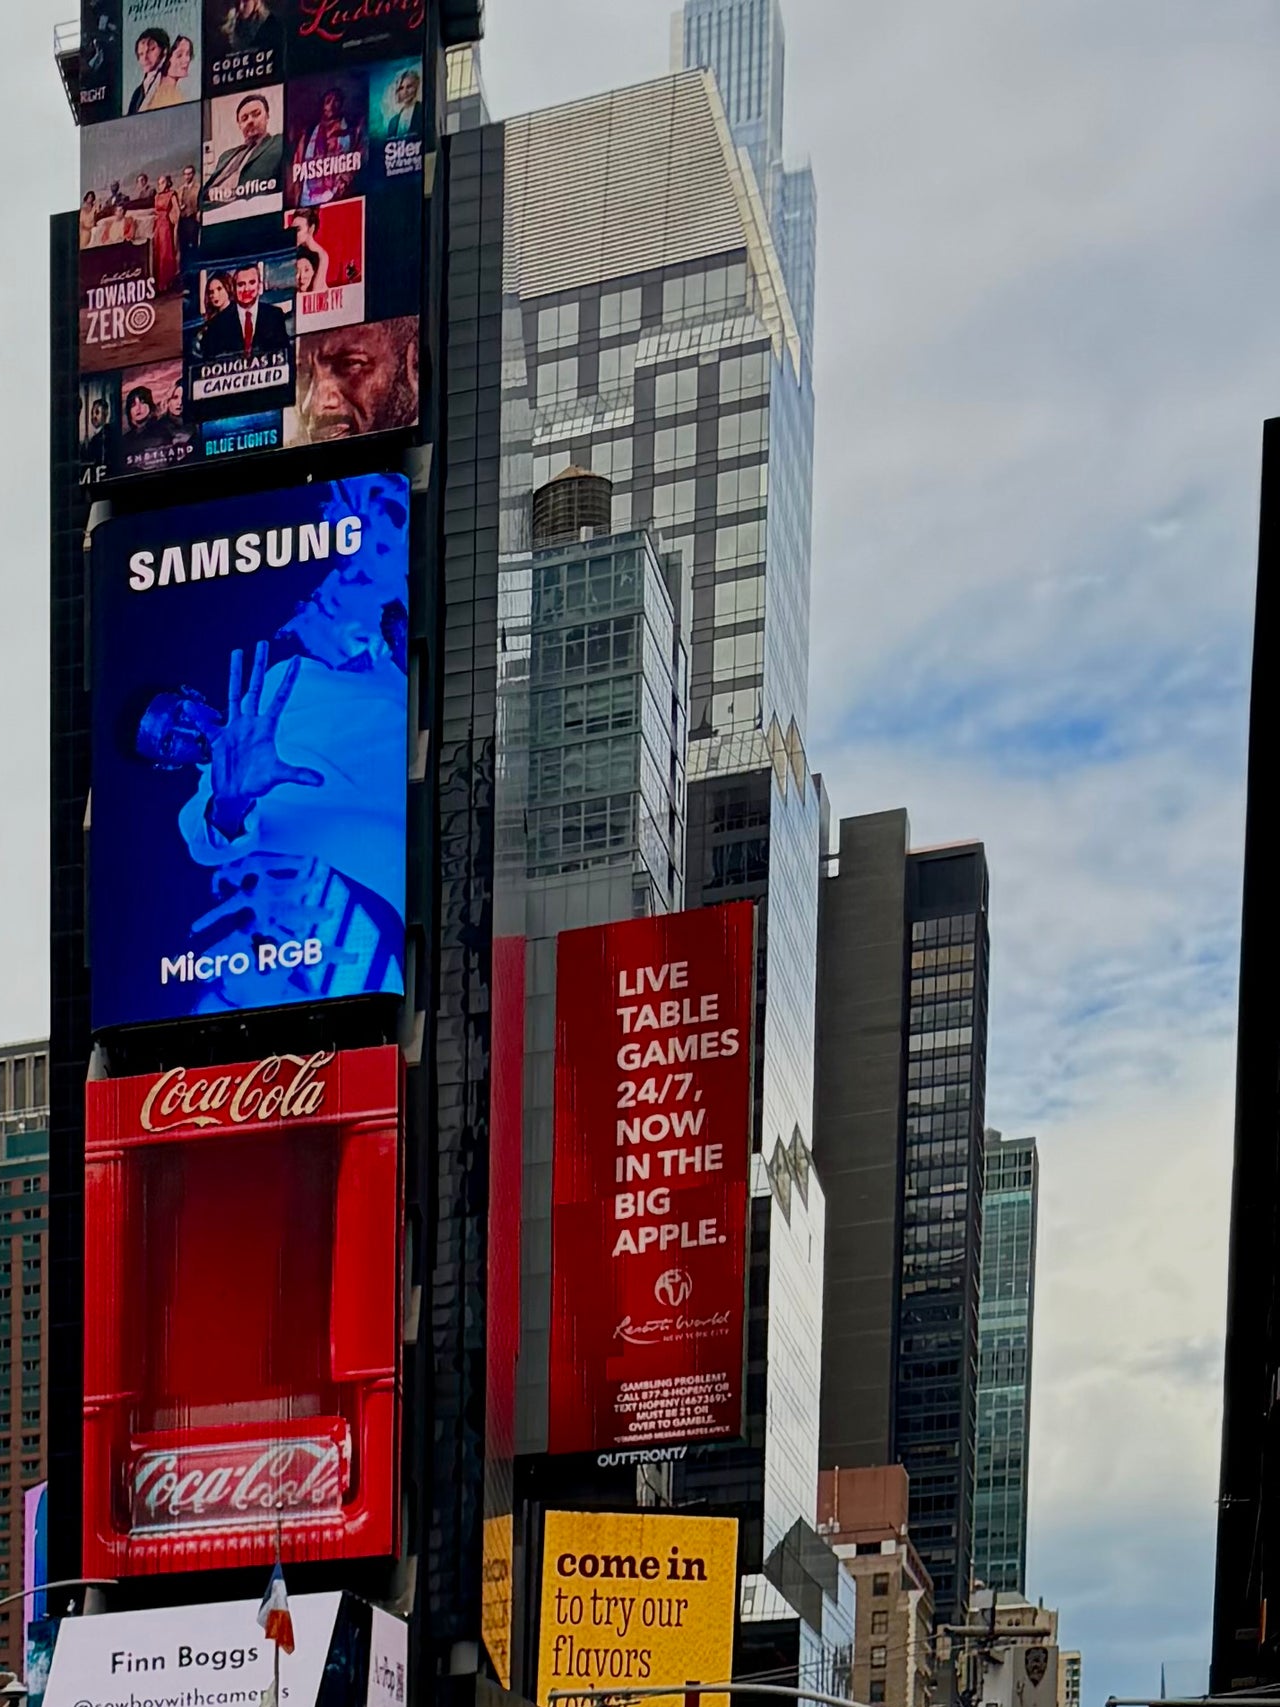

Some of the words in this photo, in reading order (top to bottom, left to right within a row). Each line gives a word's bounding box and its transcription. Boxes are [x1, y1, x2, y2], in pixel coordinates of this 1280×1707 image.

[211, 53, 251, 74] CODE
[254, 49, 275, 65] OF
[211, 62, 275, 87] SILENCE
[292, 151, 362, 184] PASSENGER
[235, 176, 278, 198] office
[86, 276, 157, 310] TOWARDS
[85, 301, 157, 345] ZERO
[200, 354, 270, 379] DOUGLAS
[272, 351, 285, 366] IS
[202, 368, 283, 394] CANCELLED
[205, 435, 235, 456] BLUE
[236, 429, 278, 450] LIGHTS
[128, 515, 363, 592] SAMSUNG
[160, 948, 250, 985] Micro
[257, 938, 324, 972] RGB
[618, 960, 690, 998] LIVE
[616, 993, 720, 1034] TABLE
[616, 1028, 741, 1072] GAMES
[139, 1049, 336, 1133] Coca-Cola
[616, 1072, 704, 1110] 24/7,
[615, 1108, 707, 1148] NOW
[614, 1153, 656, 1184] IN
[657, 1143, 724, 1179] THE
[614, 1186, 672, 1221] BIG
[611, 1217, 728, 1259] APPLE.
[616, 1391, 640, 1403] CALL
[620, 1376, 673, 1393] GAMBLING
[673, 1372, 727, 1388] PROBLEM?
[613, 1402, 638, 1414] TEXT
[628, 1420, 657, 1433] OVER
[657, 1418, 672, 1430] TO
[636, 1409, 664, 1422] MUST
[555, 1552, 661, 1580] come
[666, 1546, 708, 1582] in
[554, 1587, 584, 1627] to
[590, 1588, 636, 1638] try
[641, 1597, 689, 1629] our
[111, 1650, 166, 1674] Finn
[177, 1645, 259, 1672] Boggs
[551, 1634, 652, 1679] flavors
